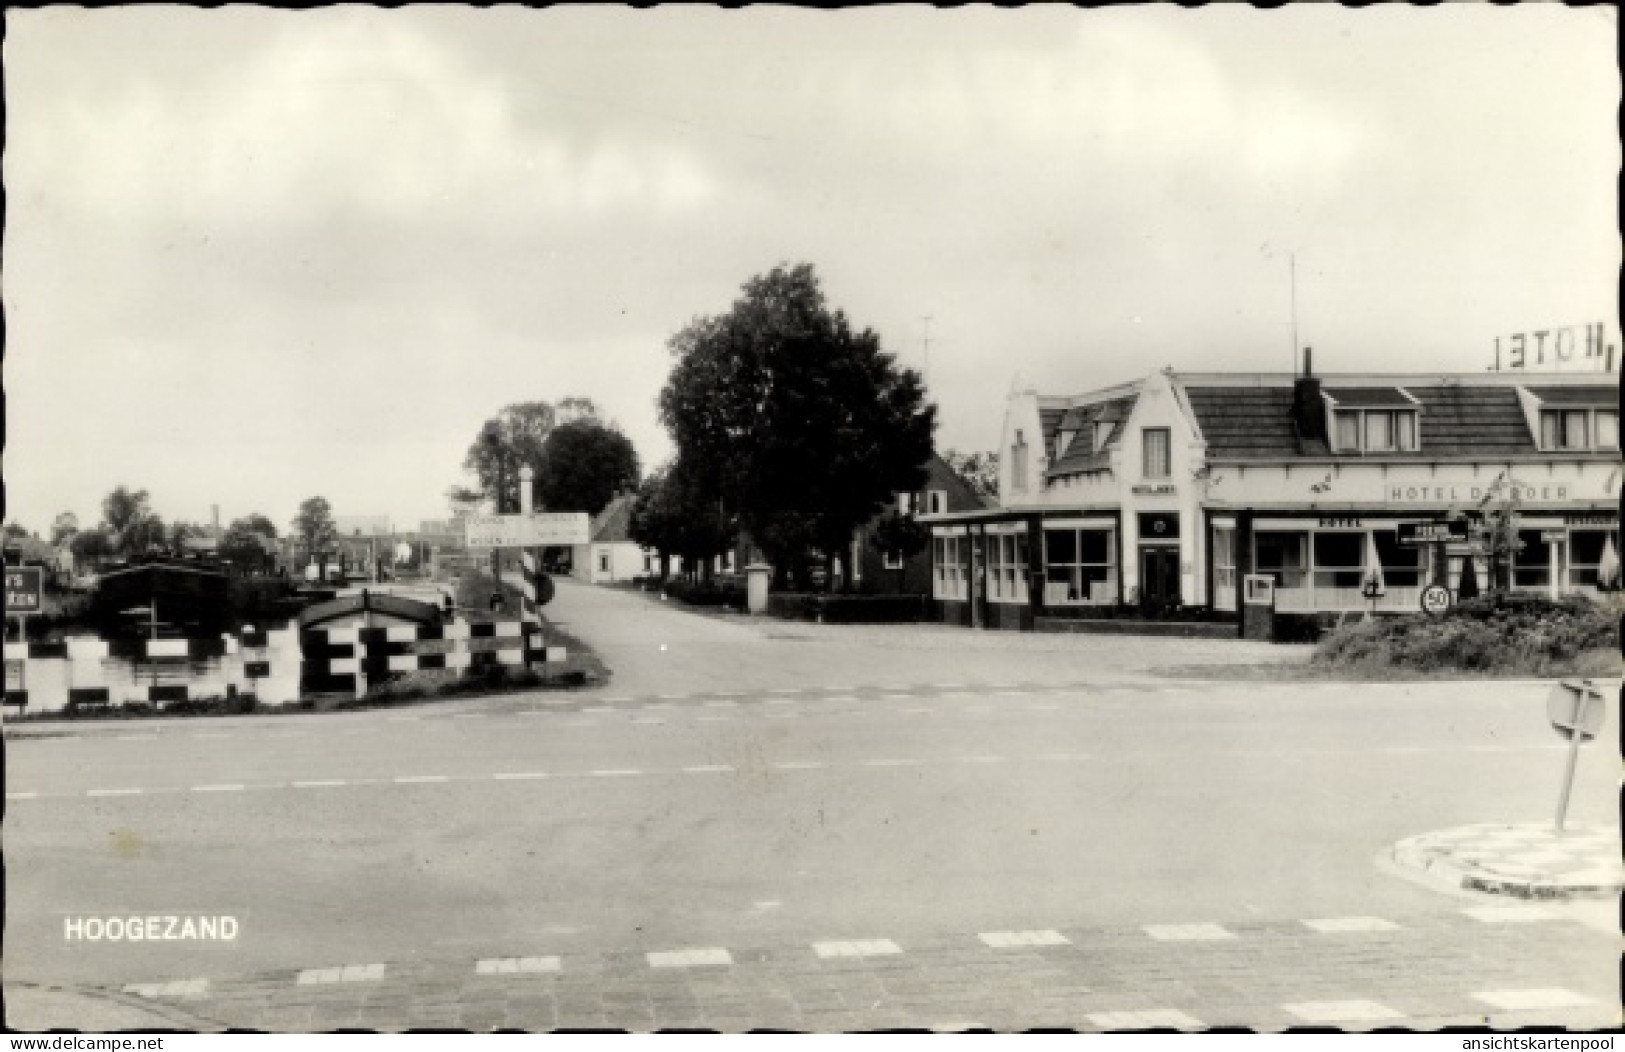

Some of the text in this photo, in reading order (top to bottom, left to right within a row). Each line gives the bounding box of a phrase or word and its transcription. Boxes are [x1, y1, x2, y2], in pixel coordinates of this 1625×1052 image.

[1391, 487, 1459, 499] HOTEL
[1319, 517, 1361, 527] HOTEL
[1427, 588, 1447, 609] 50
